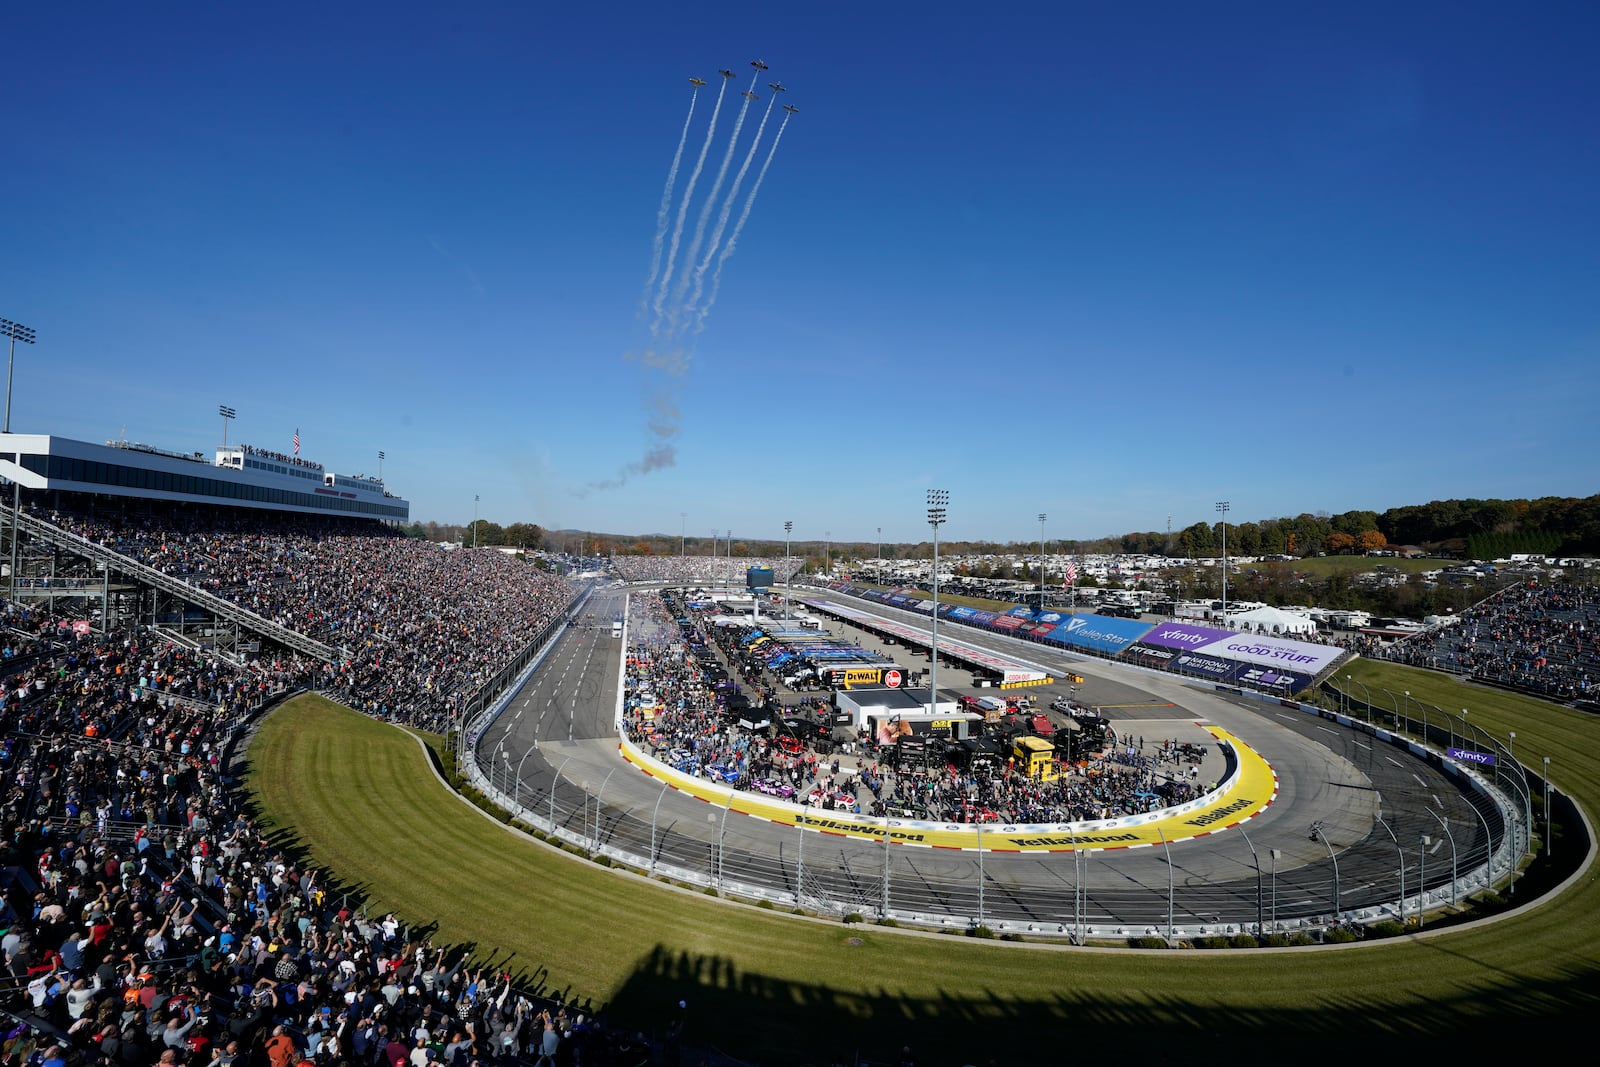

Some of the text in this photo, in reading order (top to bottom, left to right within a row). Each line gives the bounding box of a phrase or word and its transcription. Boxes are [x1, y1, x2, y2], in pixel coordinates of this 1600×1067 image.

[1074, 628, 1129, 645] ValleyStar
[1159, 629, 1209, 644] xfinity
[1145, 648, 1175, 659] BOSS
[1226, 643, 1320, 664] GOOD STUFF
[1190, 656, 1231, 671] NATIONAL
[1453, 750, 1488, 763] xfinity
[1184, 798, 1255, 827] YellaWood
[794, 815, 925, 842] YellaWood
[1007, 833, 1141, 847] YellaWood
